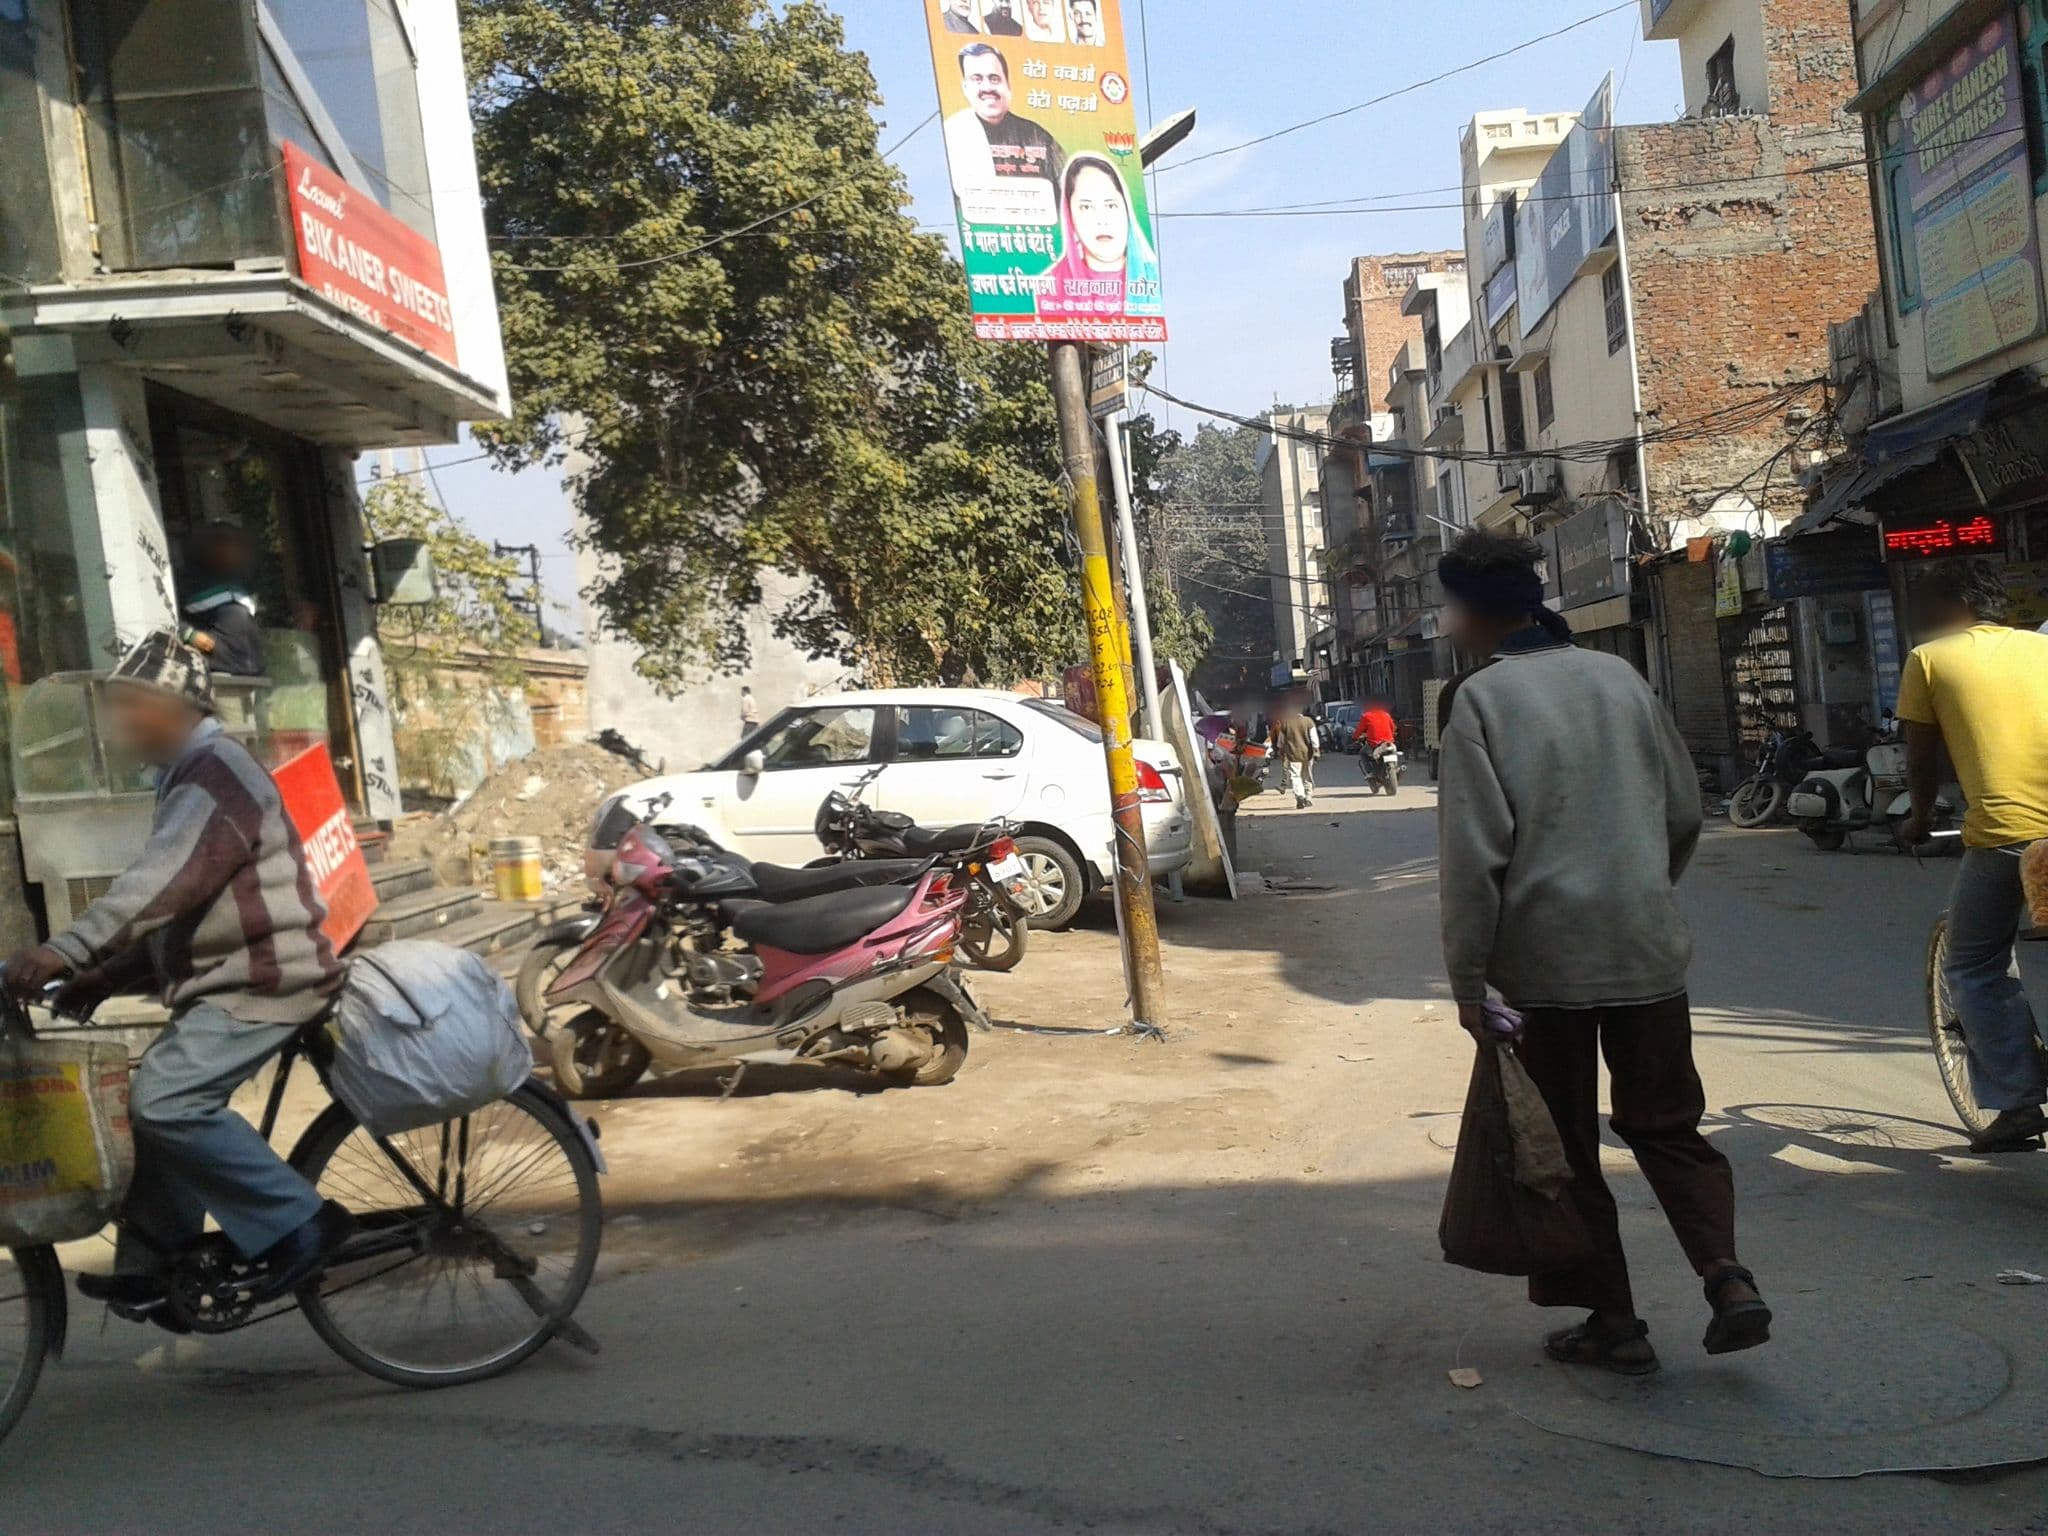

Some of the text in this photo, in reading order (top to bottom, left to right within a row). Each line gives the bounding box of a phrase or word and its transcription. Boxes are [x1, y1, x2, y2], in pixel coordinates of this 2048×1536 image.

[1023, 59, 1096, 83] बेटी बचाओ
[1027, 89, 1051, 108] बेटी
[1952, 45, 2008, 114] GANESH
[1919, 86, 2008, 174] ENTERPRISES
[301, 211, 453, 332] BIKANER SWEETS
[1091, 366, 1123, 391] PUBLIC
[303, 808, 356, 887] SWEETS
